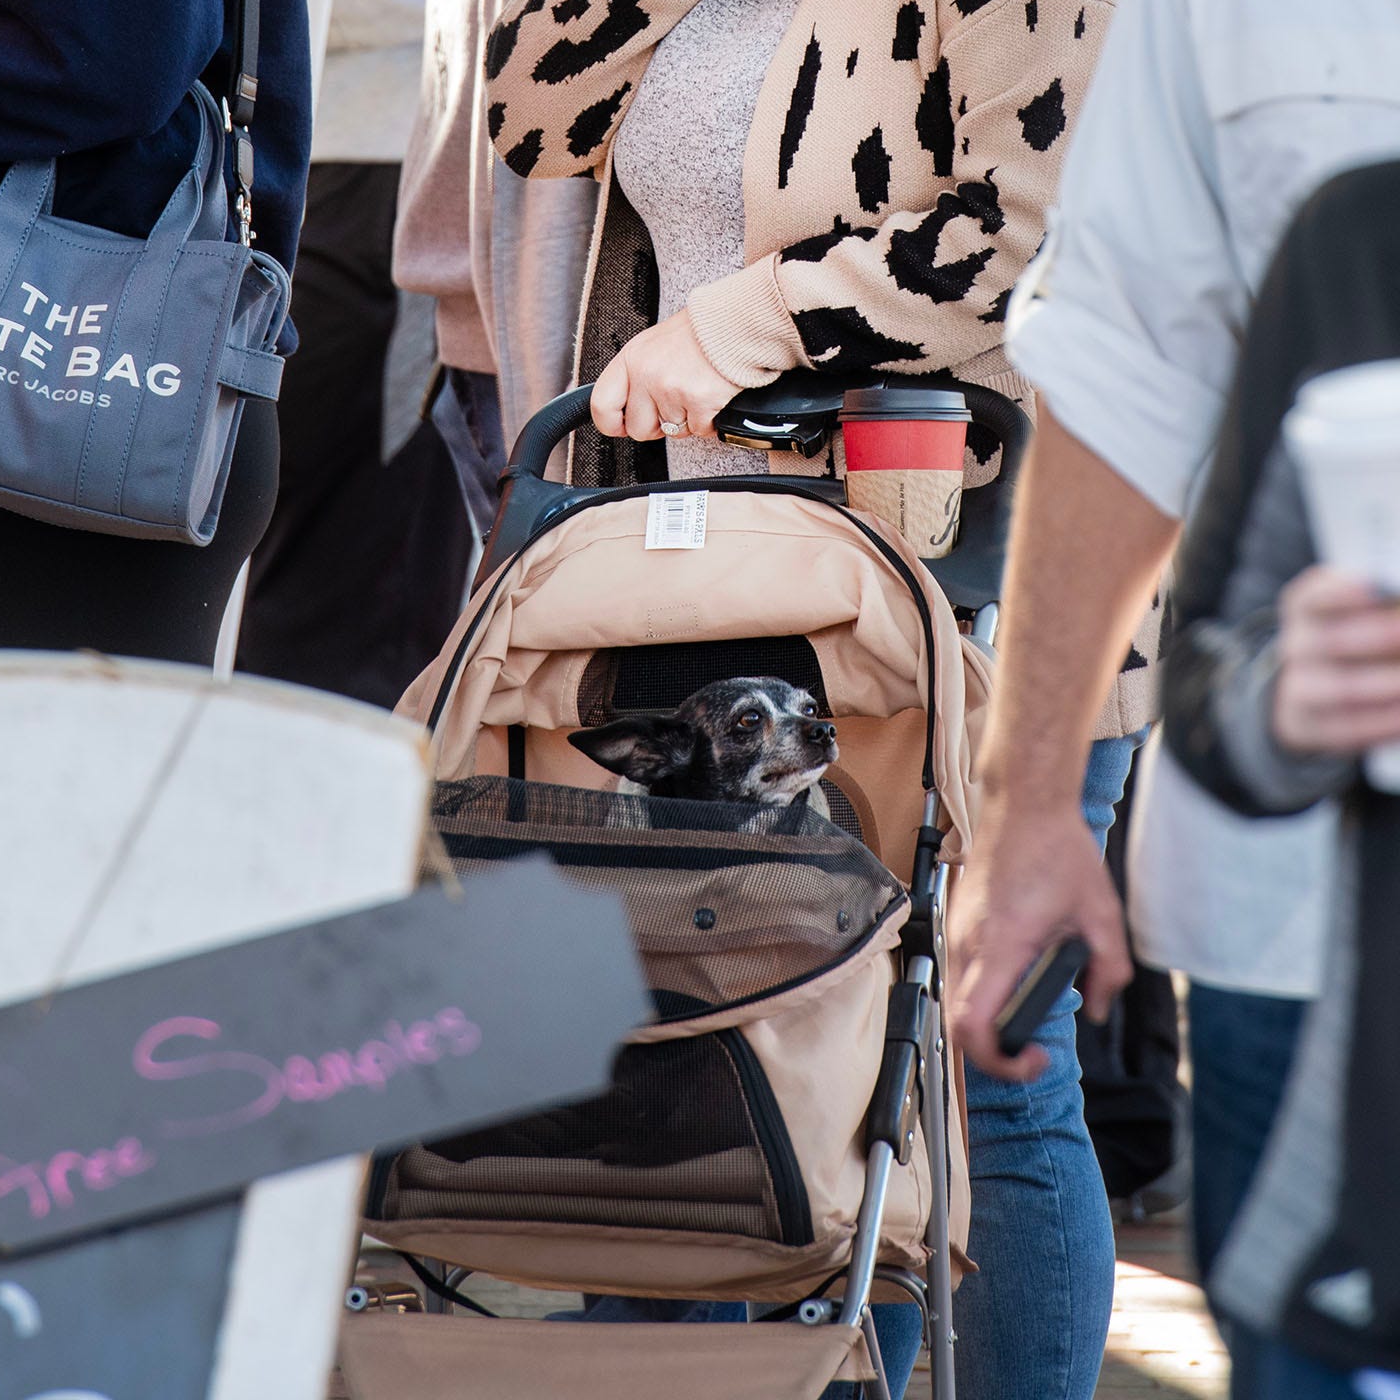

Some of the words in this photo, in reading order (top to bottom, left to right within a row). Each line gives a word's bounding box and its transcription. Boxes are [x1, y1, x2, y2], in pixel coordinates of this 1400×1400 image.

[20, 281, 108, 337] THE
[23, 378, 112, 408] JACOBS
[65, 345, 182, 397] BAG
[132, 1007, 482, 1139] Samples
